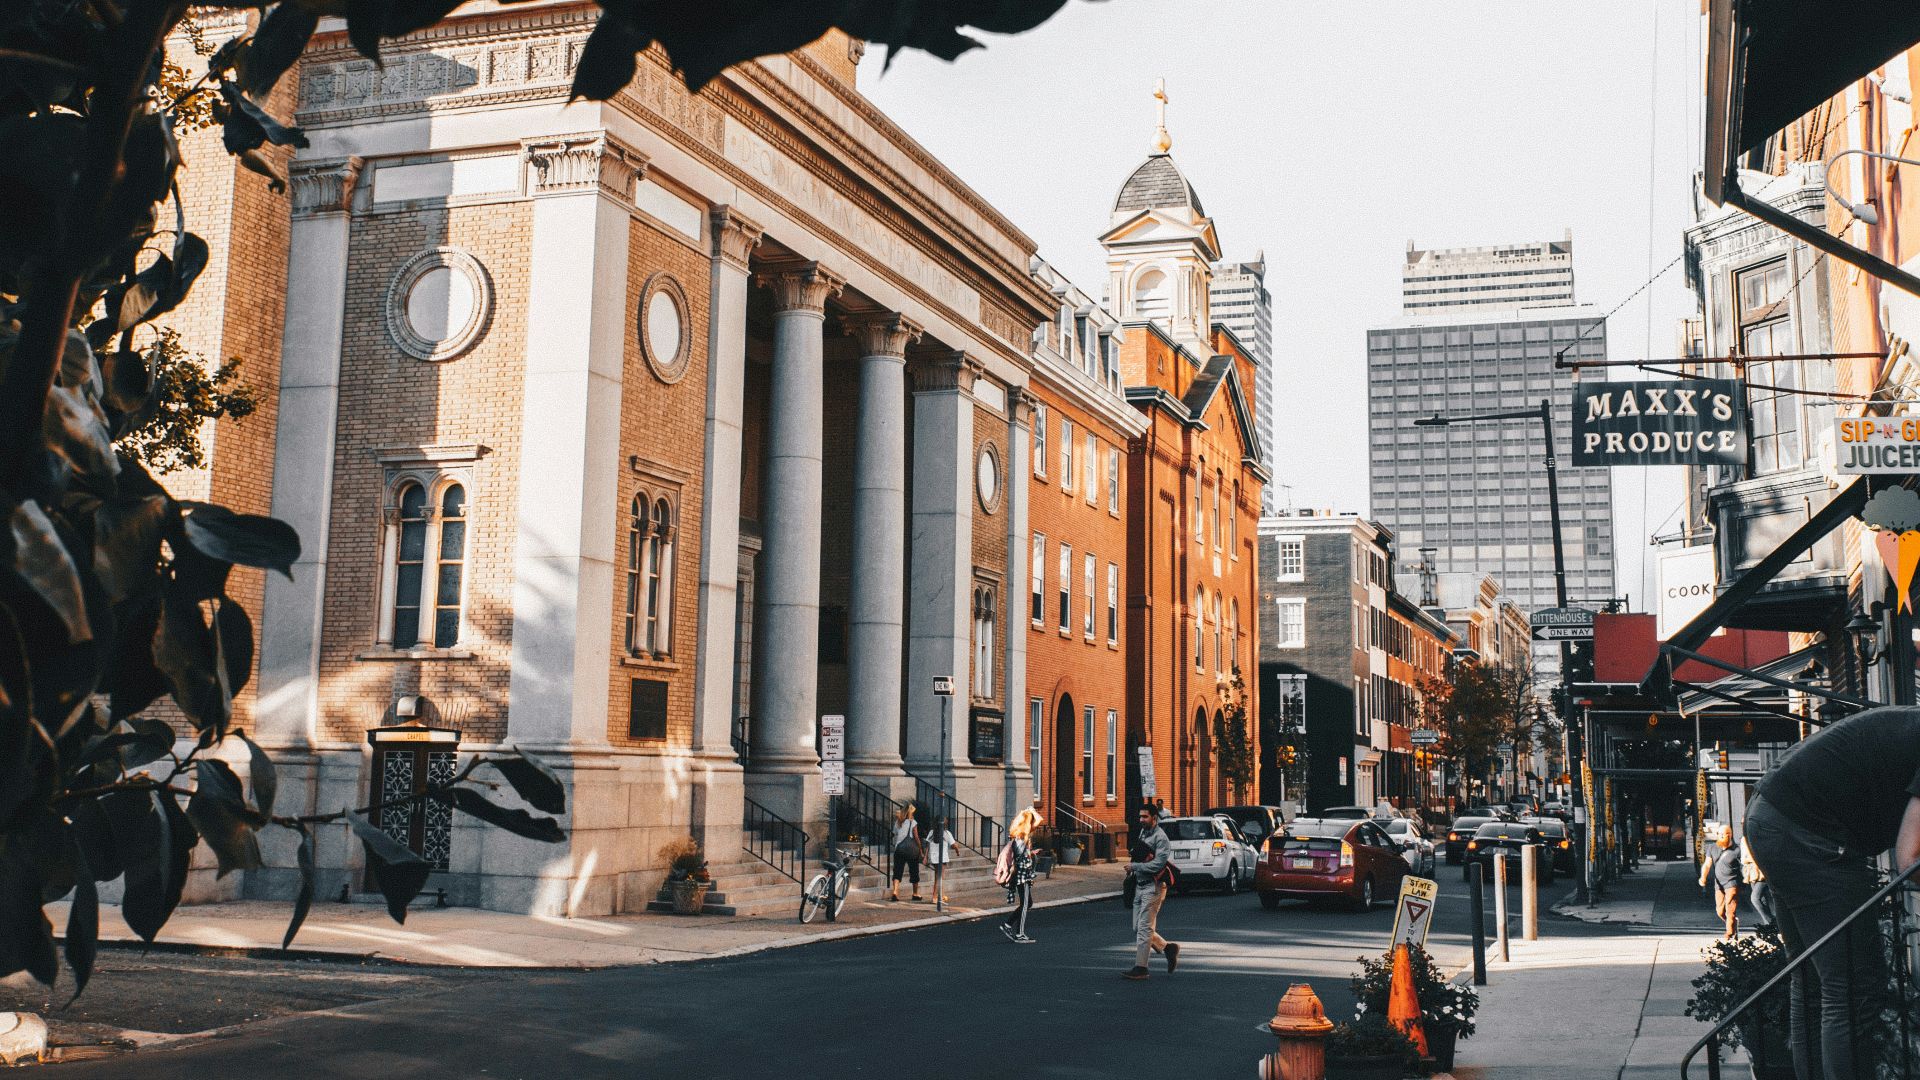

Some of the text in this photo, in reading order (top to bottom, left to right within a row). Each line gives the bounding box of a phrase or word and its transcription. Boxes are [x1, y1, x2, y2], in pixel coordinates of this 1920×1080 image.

[1585, 389, 1732, 423] MAXX'S
[1584, 431, 1736, 453] PRODUCE
[1668, 583, 1710, 598] COOK
[1532, 613, 1587, 623] RITTENHOUSE
[1571, 628, 1590, 636] WAY
[1412, 888, 1427, 897] LAW
